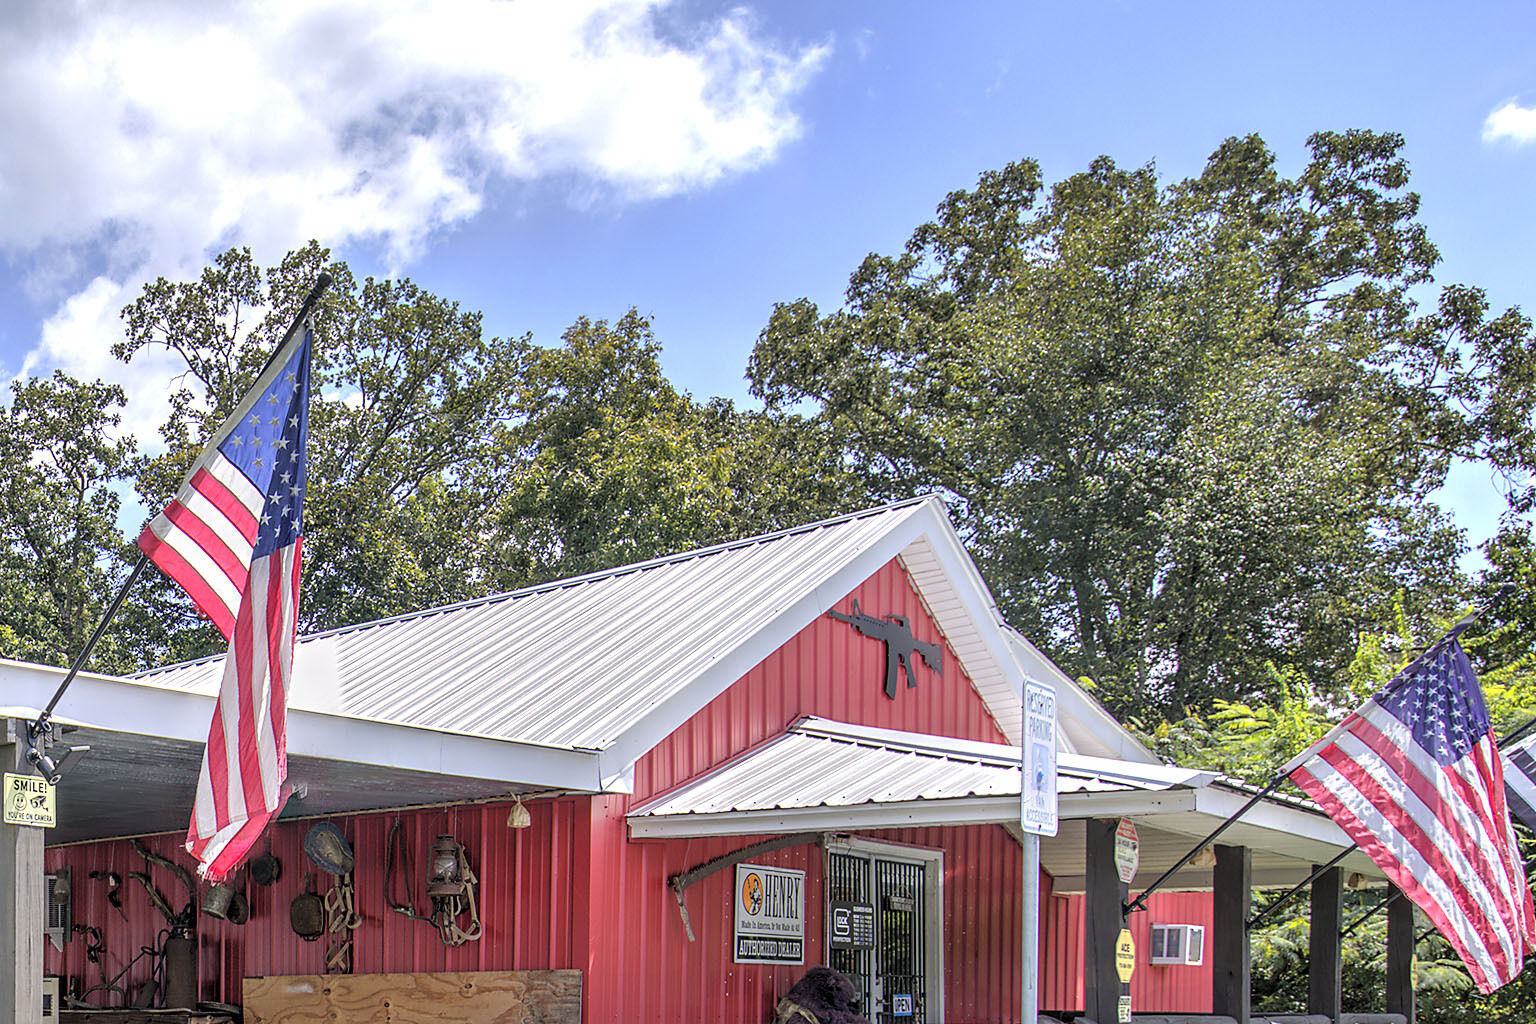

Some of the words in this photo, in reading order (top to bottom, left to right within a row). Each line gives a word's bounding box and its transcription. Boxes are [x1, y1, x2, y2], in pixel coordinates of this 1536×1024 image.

[1027, 689, 1054, 720] RESERVED
[1029, 716, 1052, 742] PARKING
[14, 779, 47, 793] SMILE!
[8, 811, 24, 819] YOU'RE
[764, 874, 801, 919] HENRY
[778, 941, 801, 957] DEALER
